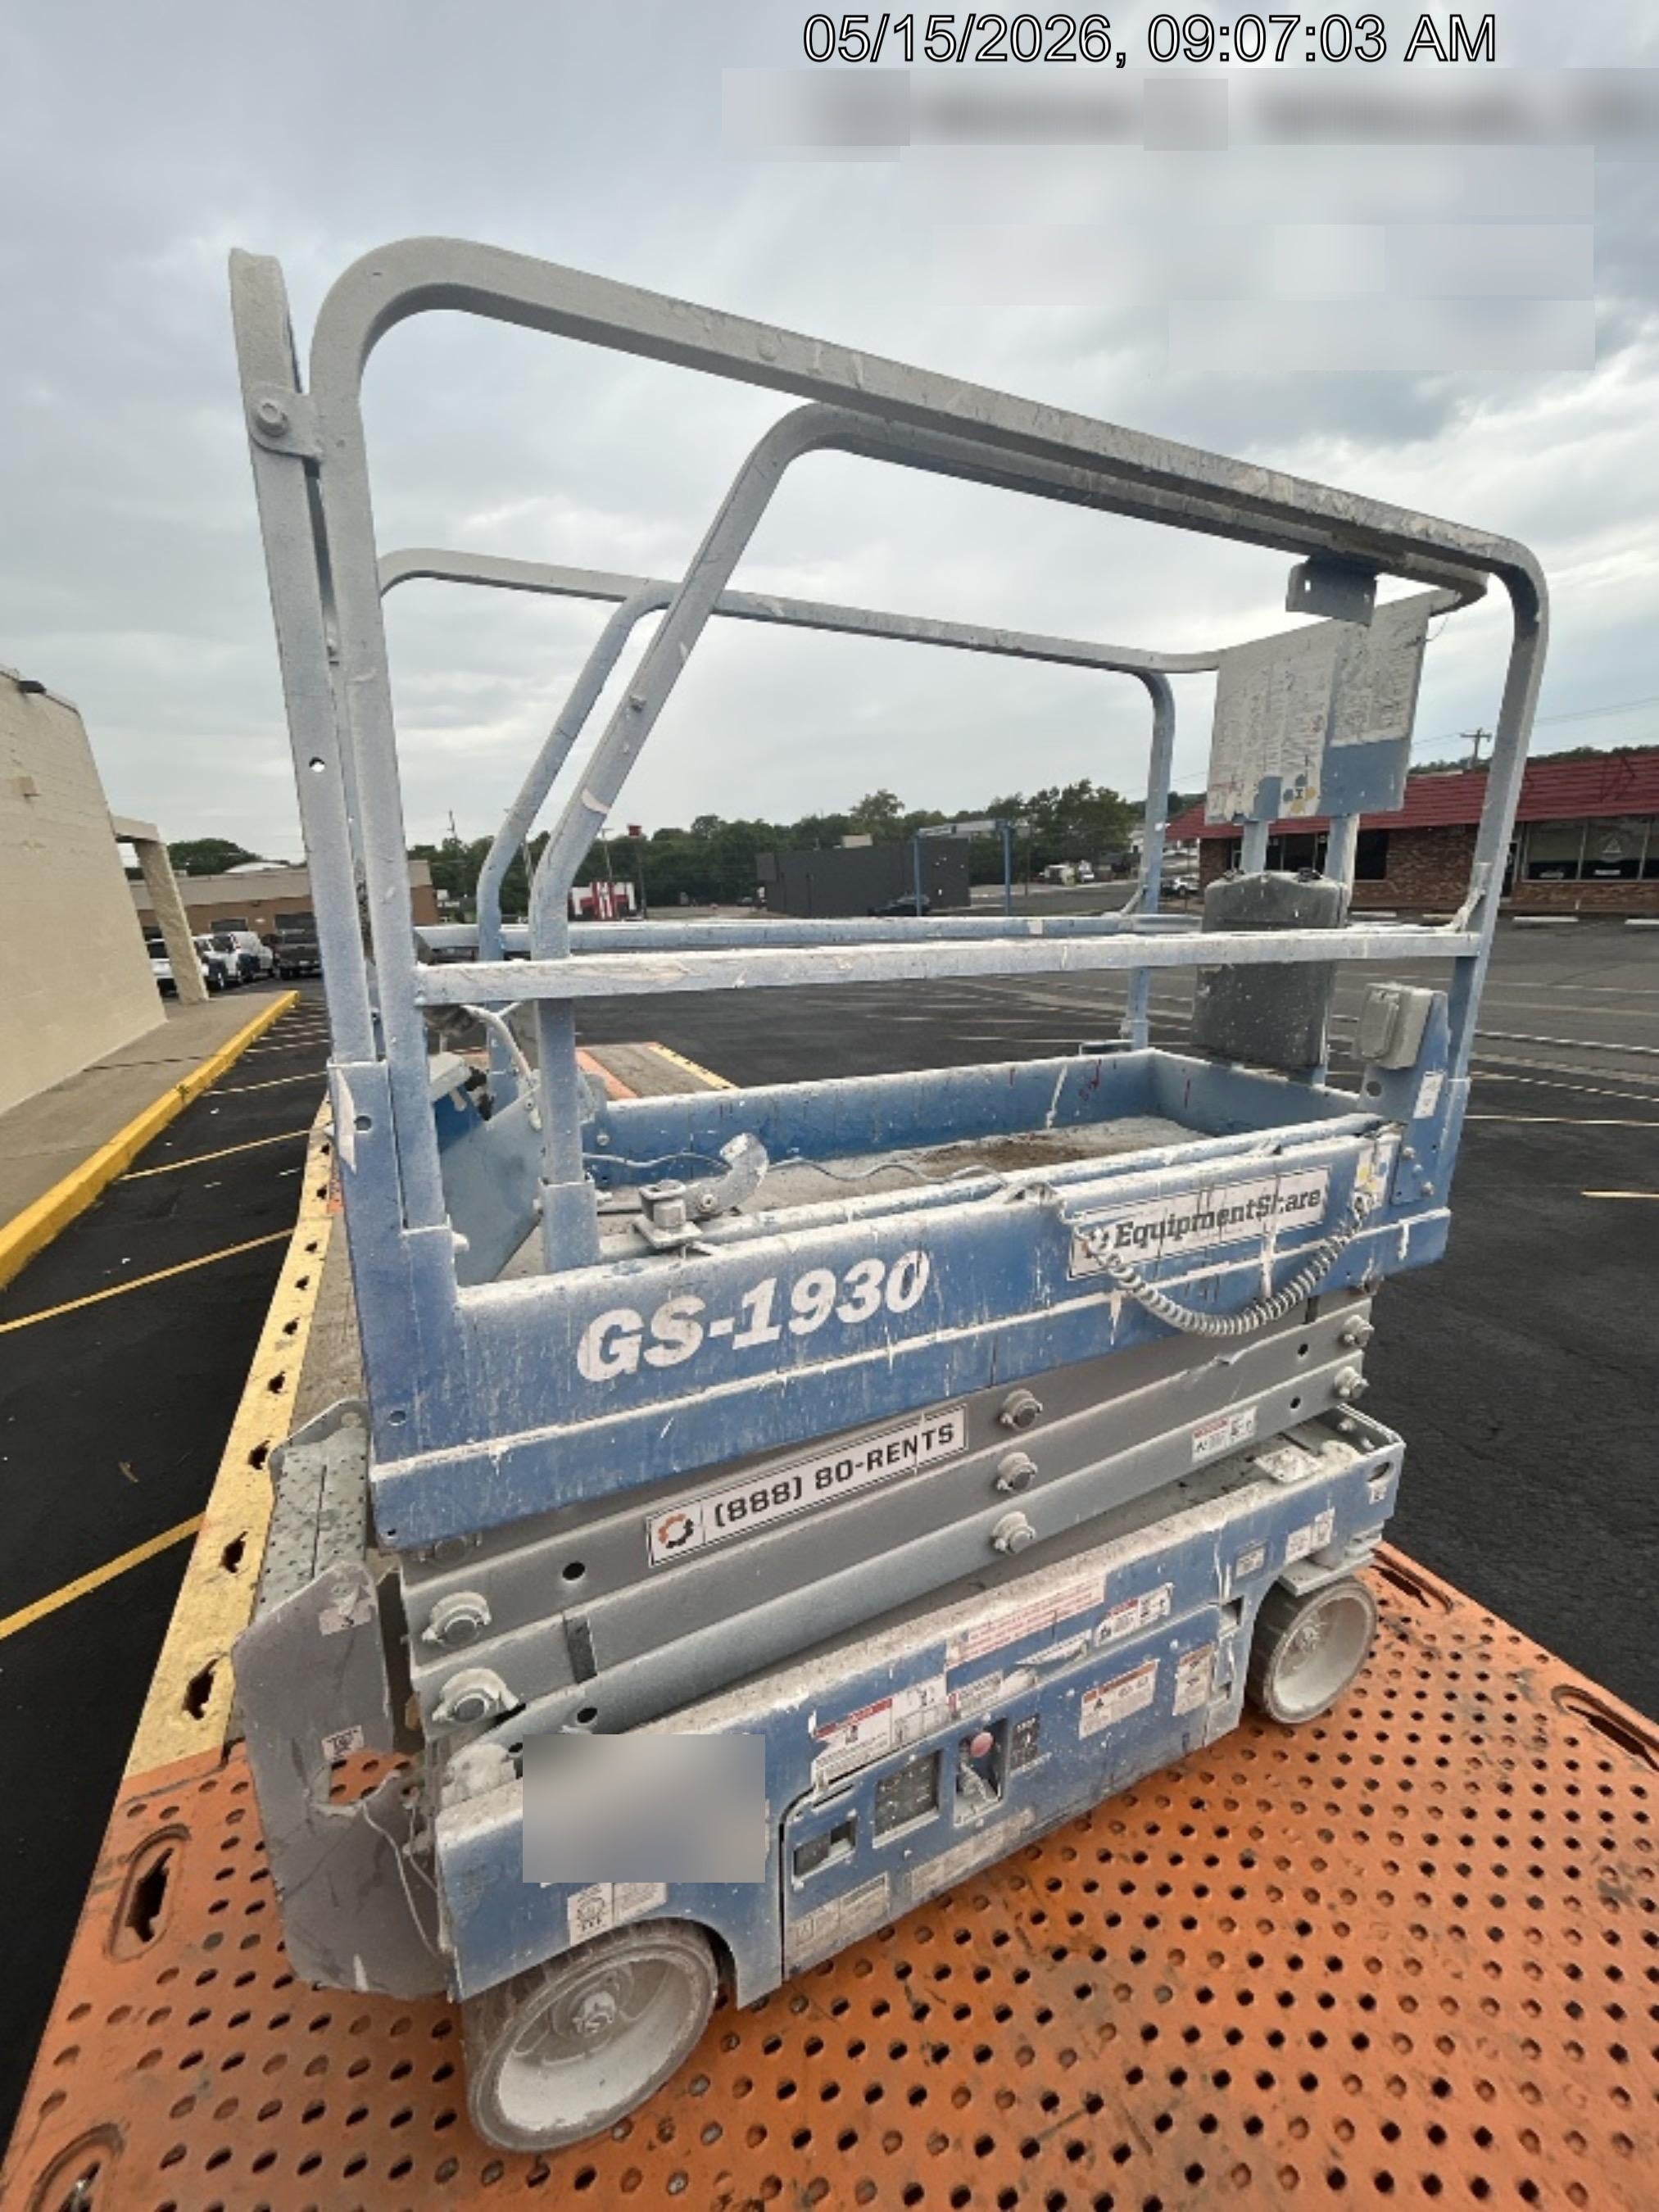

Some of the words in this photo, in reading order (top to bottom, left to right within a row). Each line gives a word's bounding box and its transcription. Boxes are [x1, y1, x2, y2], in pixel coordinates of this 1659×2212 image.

[576, 1249, 931, 1382] GS-1930
[714, 1476, 802, 1528] (888)
[814, 1422, 955, 1491] 80-RENTS
